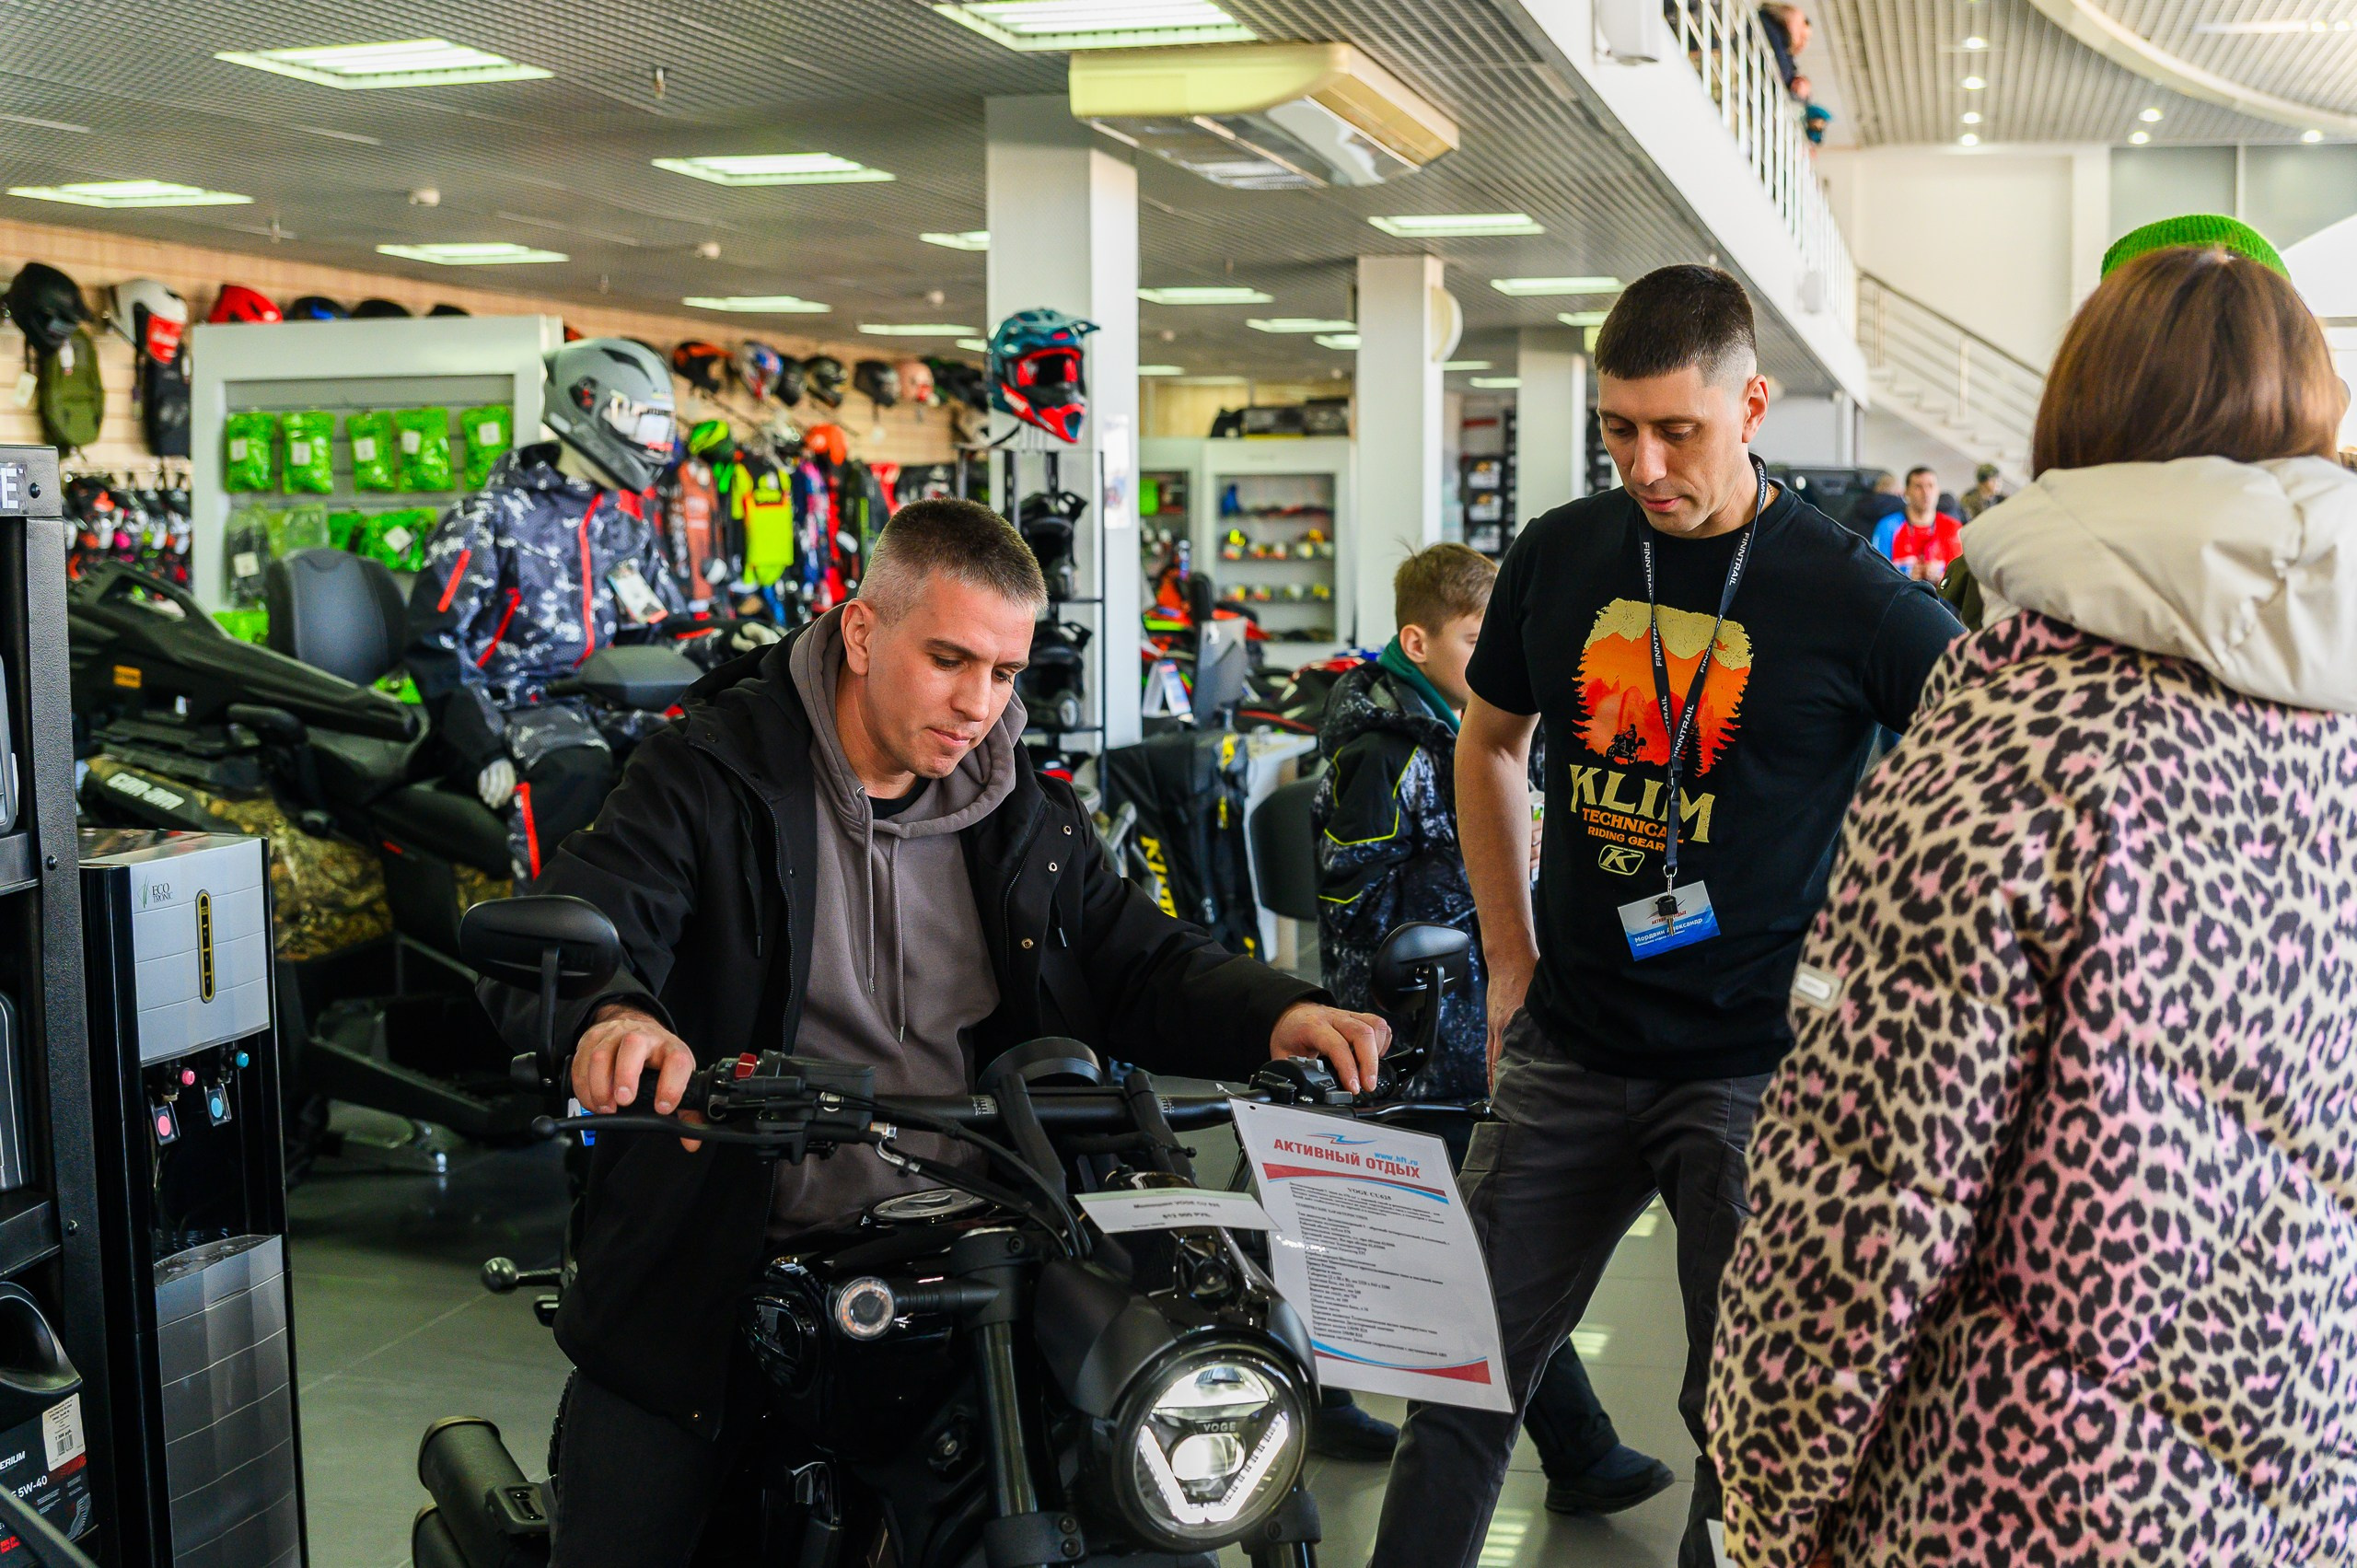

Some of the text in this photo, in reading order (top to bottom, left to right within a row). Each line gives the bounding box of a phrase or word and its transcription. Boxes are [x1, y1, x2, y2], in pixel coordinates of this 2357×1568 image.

[1728, 532, 1750, 587] FINNTRAIL
[1569, 763, 1716, 843] KLIM
[1587, 825, 1666, 852] RIDING GEAR
[152, 882, 170, 896] ECO
[153, 891, 174, 903] TRONIC
[1634, 929, 1666, 944] Мордвин
[1273, 1138, 1422, 1179] АКТИВНЫЙ ОТДЫХ
[1202, 1421, 1237, 1433] VOGE
[18, 1474, 48, 1499] 5W-40
